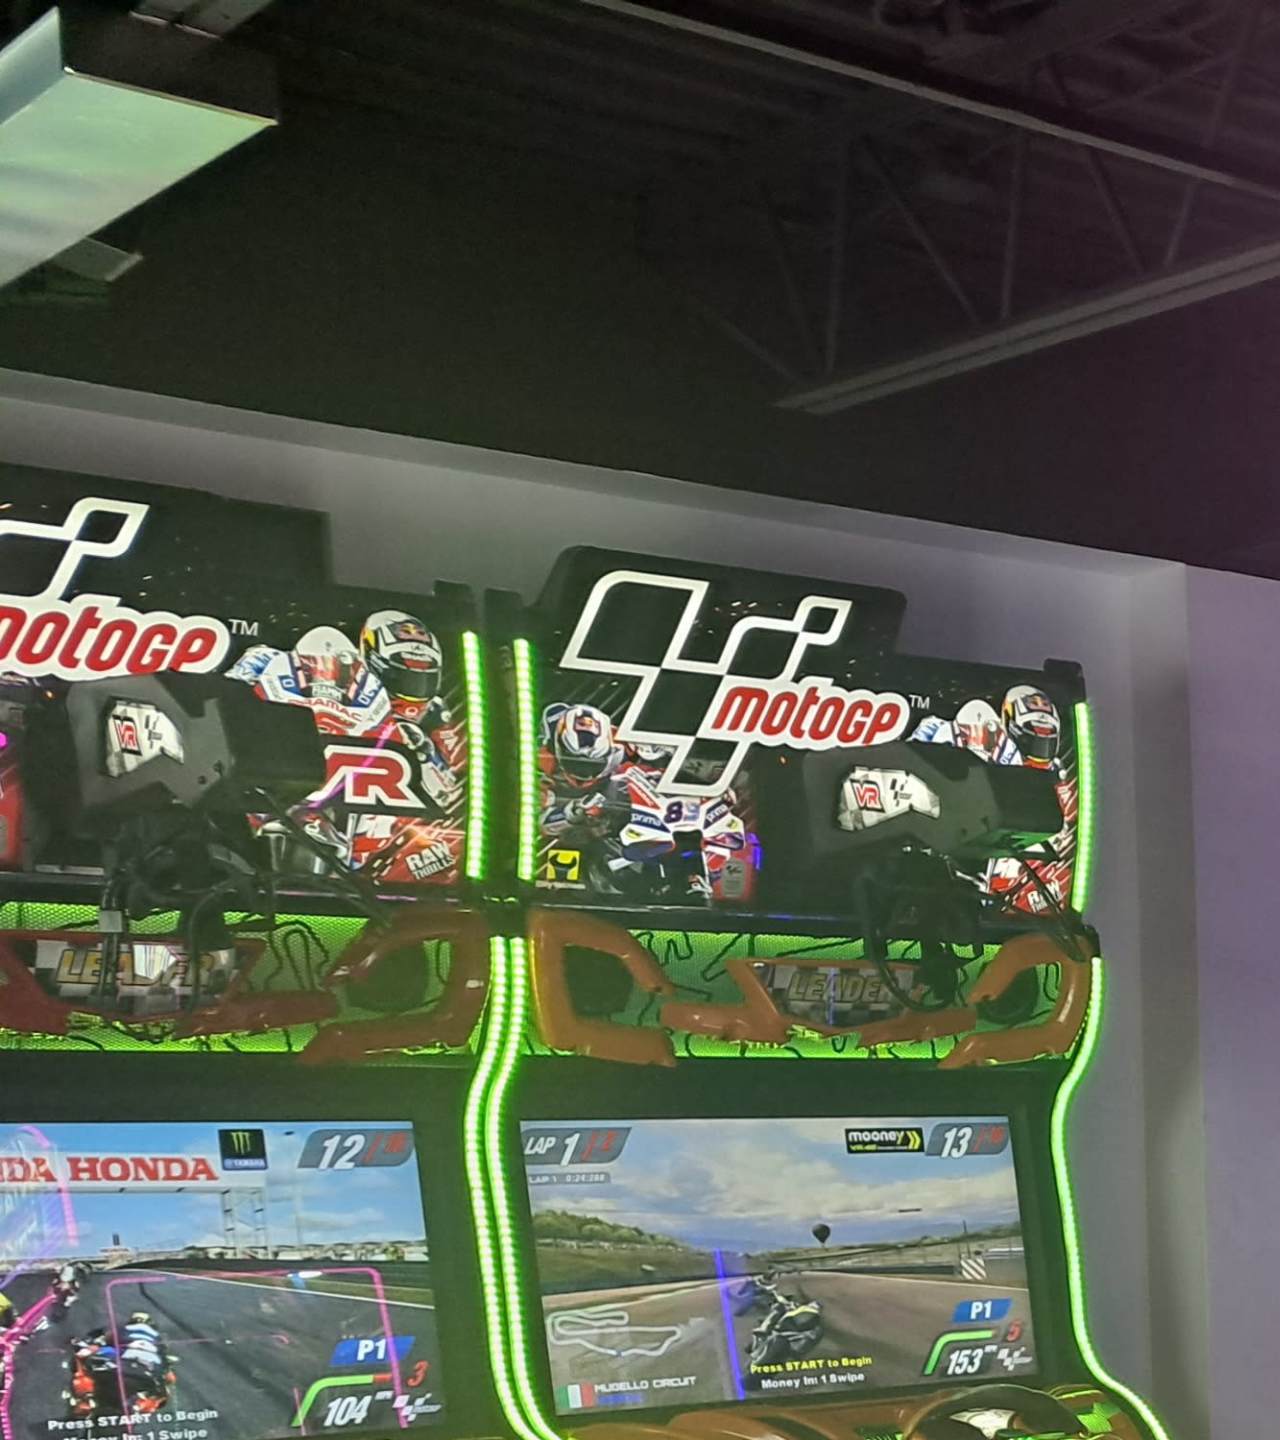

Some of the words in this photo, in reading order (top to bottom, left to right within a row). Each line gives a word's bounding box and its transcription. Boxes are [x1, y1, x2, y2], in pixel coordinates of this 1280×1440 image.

[524, 1136, 556, 1155] LAP
[560, 1132, 580, 1166] 1
[848, 1130, 905, 1145] mooney
[941, 1126, 973, 1158] 13
[319, 1134, 366, 1170] 12
[67, 1156, 219, 1183] HONDA
[970, 1300, 993, 1320] P1
[357, 1339, 388, 1361] P1
[751, 1362, 783, 1374] Press
[786, 1359, 824, 1371] START
[827, 1357, 839, 1368] to
[842, 1355, 873, 1369] Begin
[946, 1349, 984, 1375] 153
[653, 1375, 697, 1389] CIRCUIT
[761, 1377, 800, 1390] Money
[829, 1372, 865, 1385] Swipe
[47, 1418, 94, 1431] Press
[98, 1413, 152, 1428] START
[157, 1412, 172, 1423] to
[176, 1408, 218, 1423] Begin
[324, 1395, 372, 1427] 104
